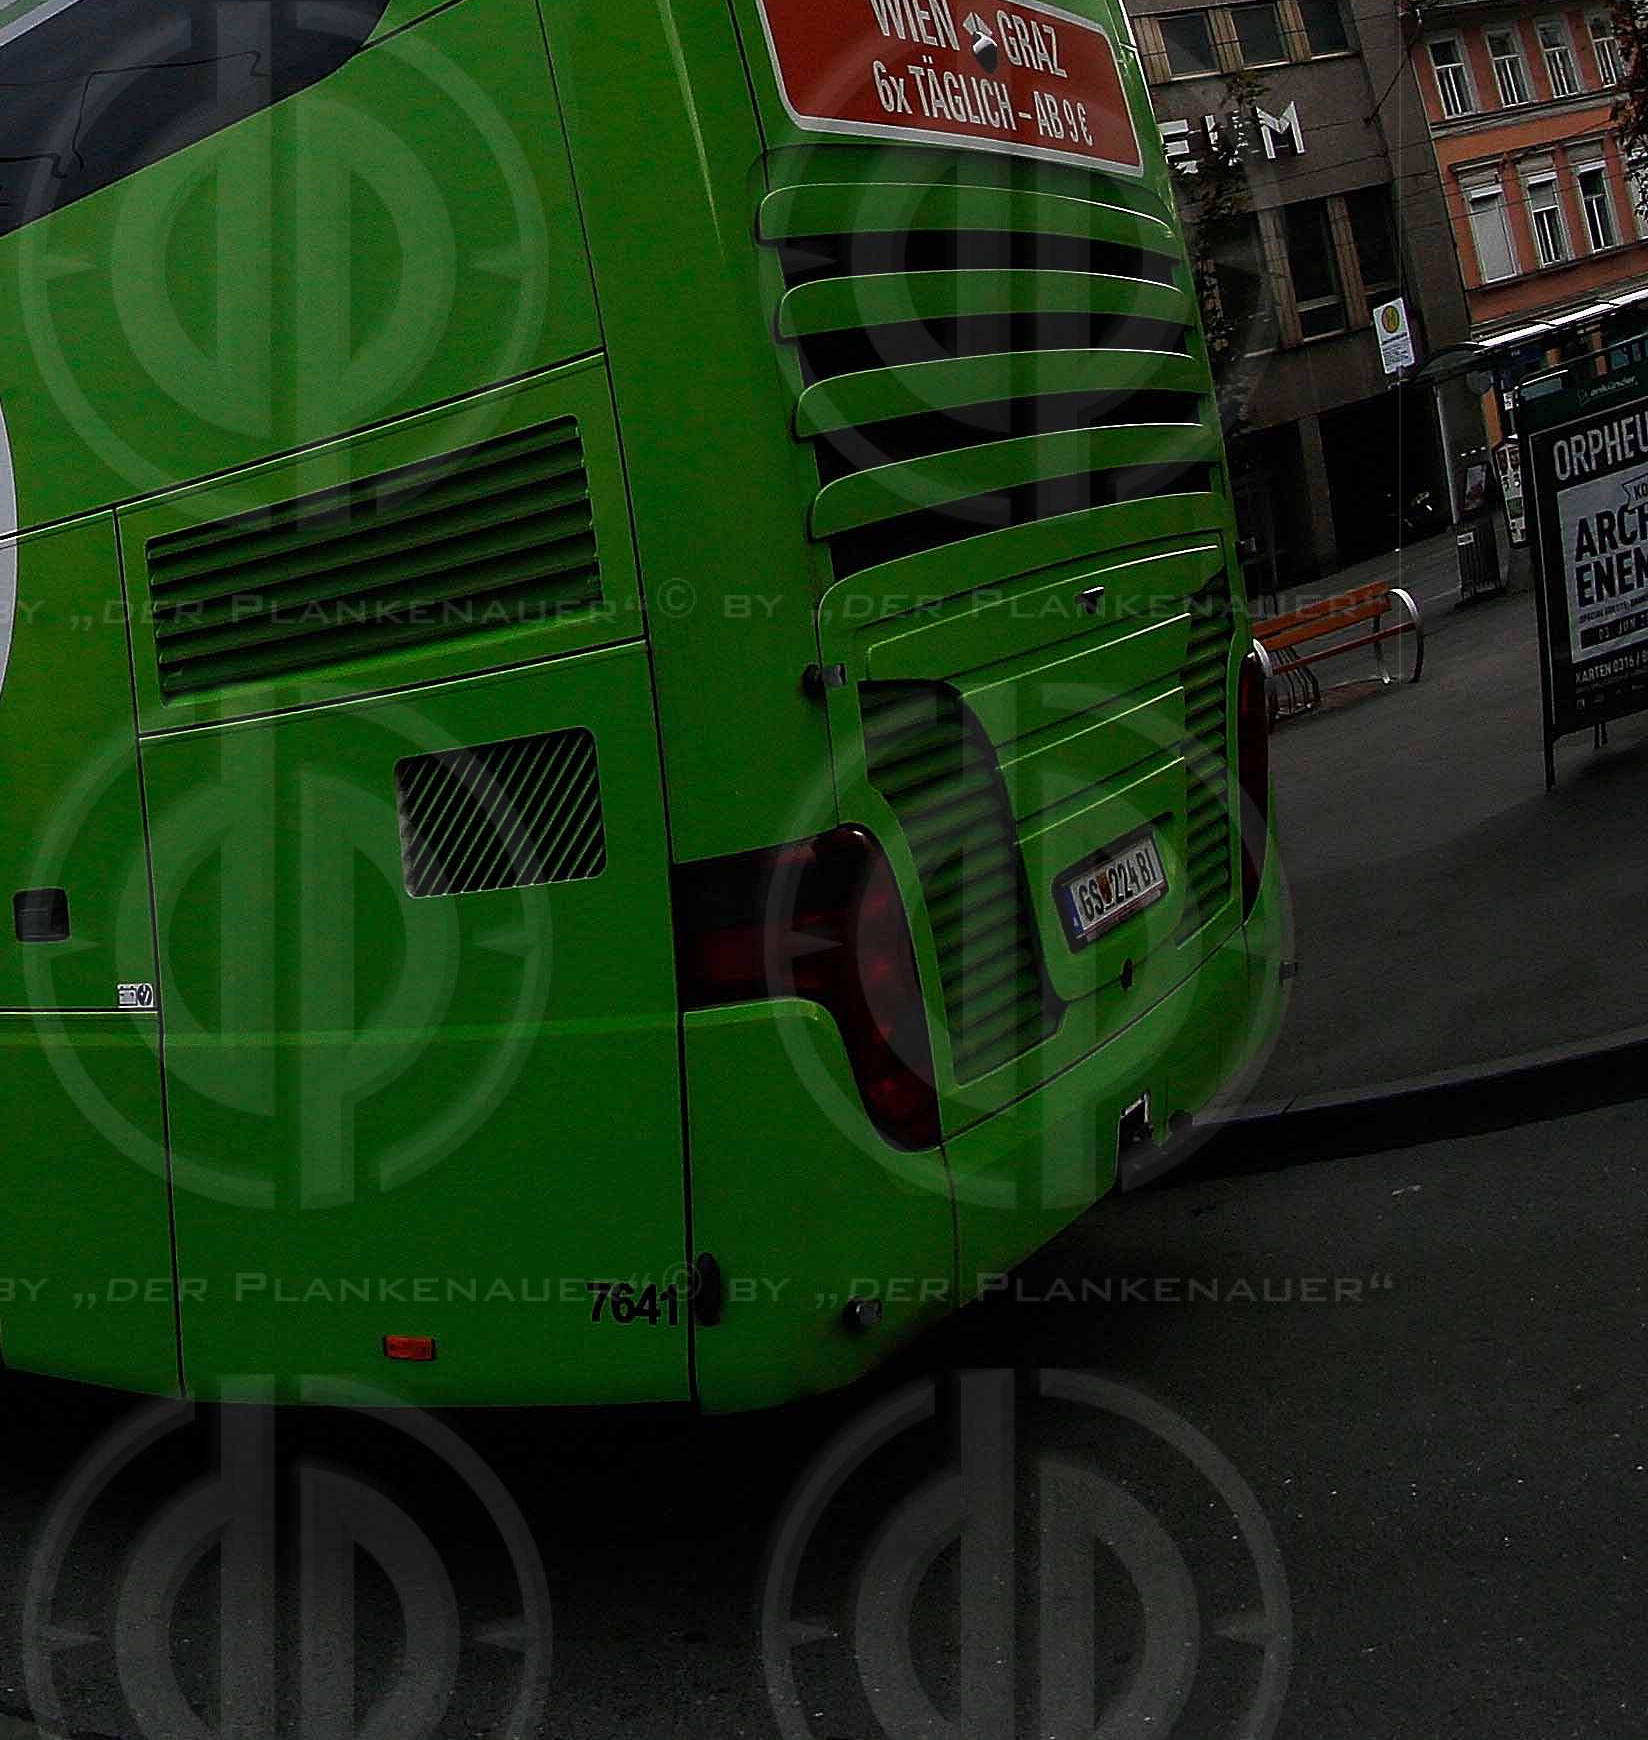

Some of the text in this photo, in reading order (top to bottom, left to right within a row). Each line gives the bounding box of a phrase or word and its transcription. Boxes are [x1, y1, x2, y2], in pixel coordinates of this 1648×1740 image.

[996, 9, 1069, 79] GRAZ
[872, 60, 913, 115] 6x
[907, 55, 1018, 131] TÄGLICH
[1033, 91, 1066, 139] AB
[585, 1282, 679, 1326] 7641
